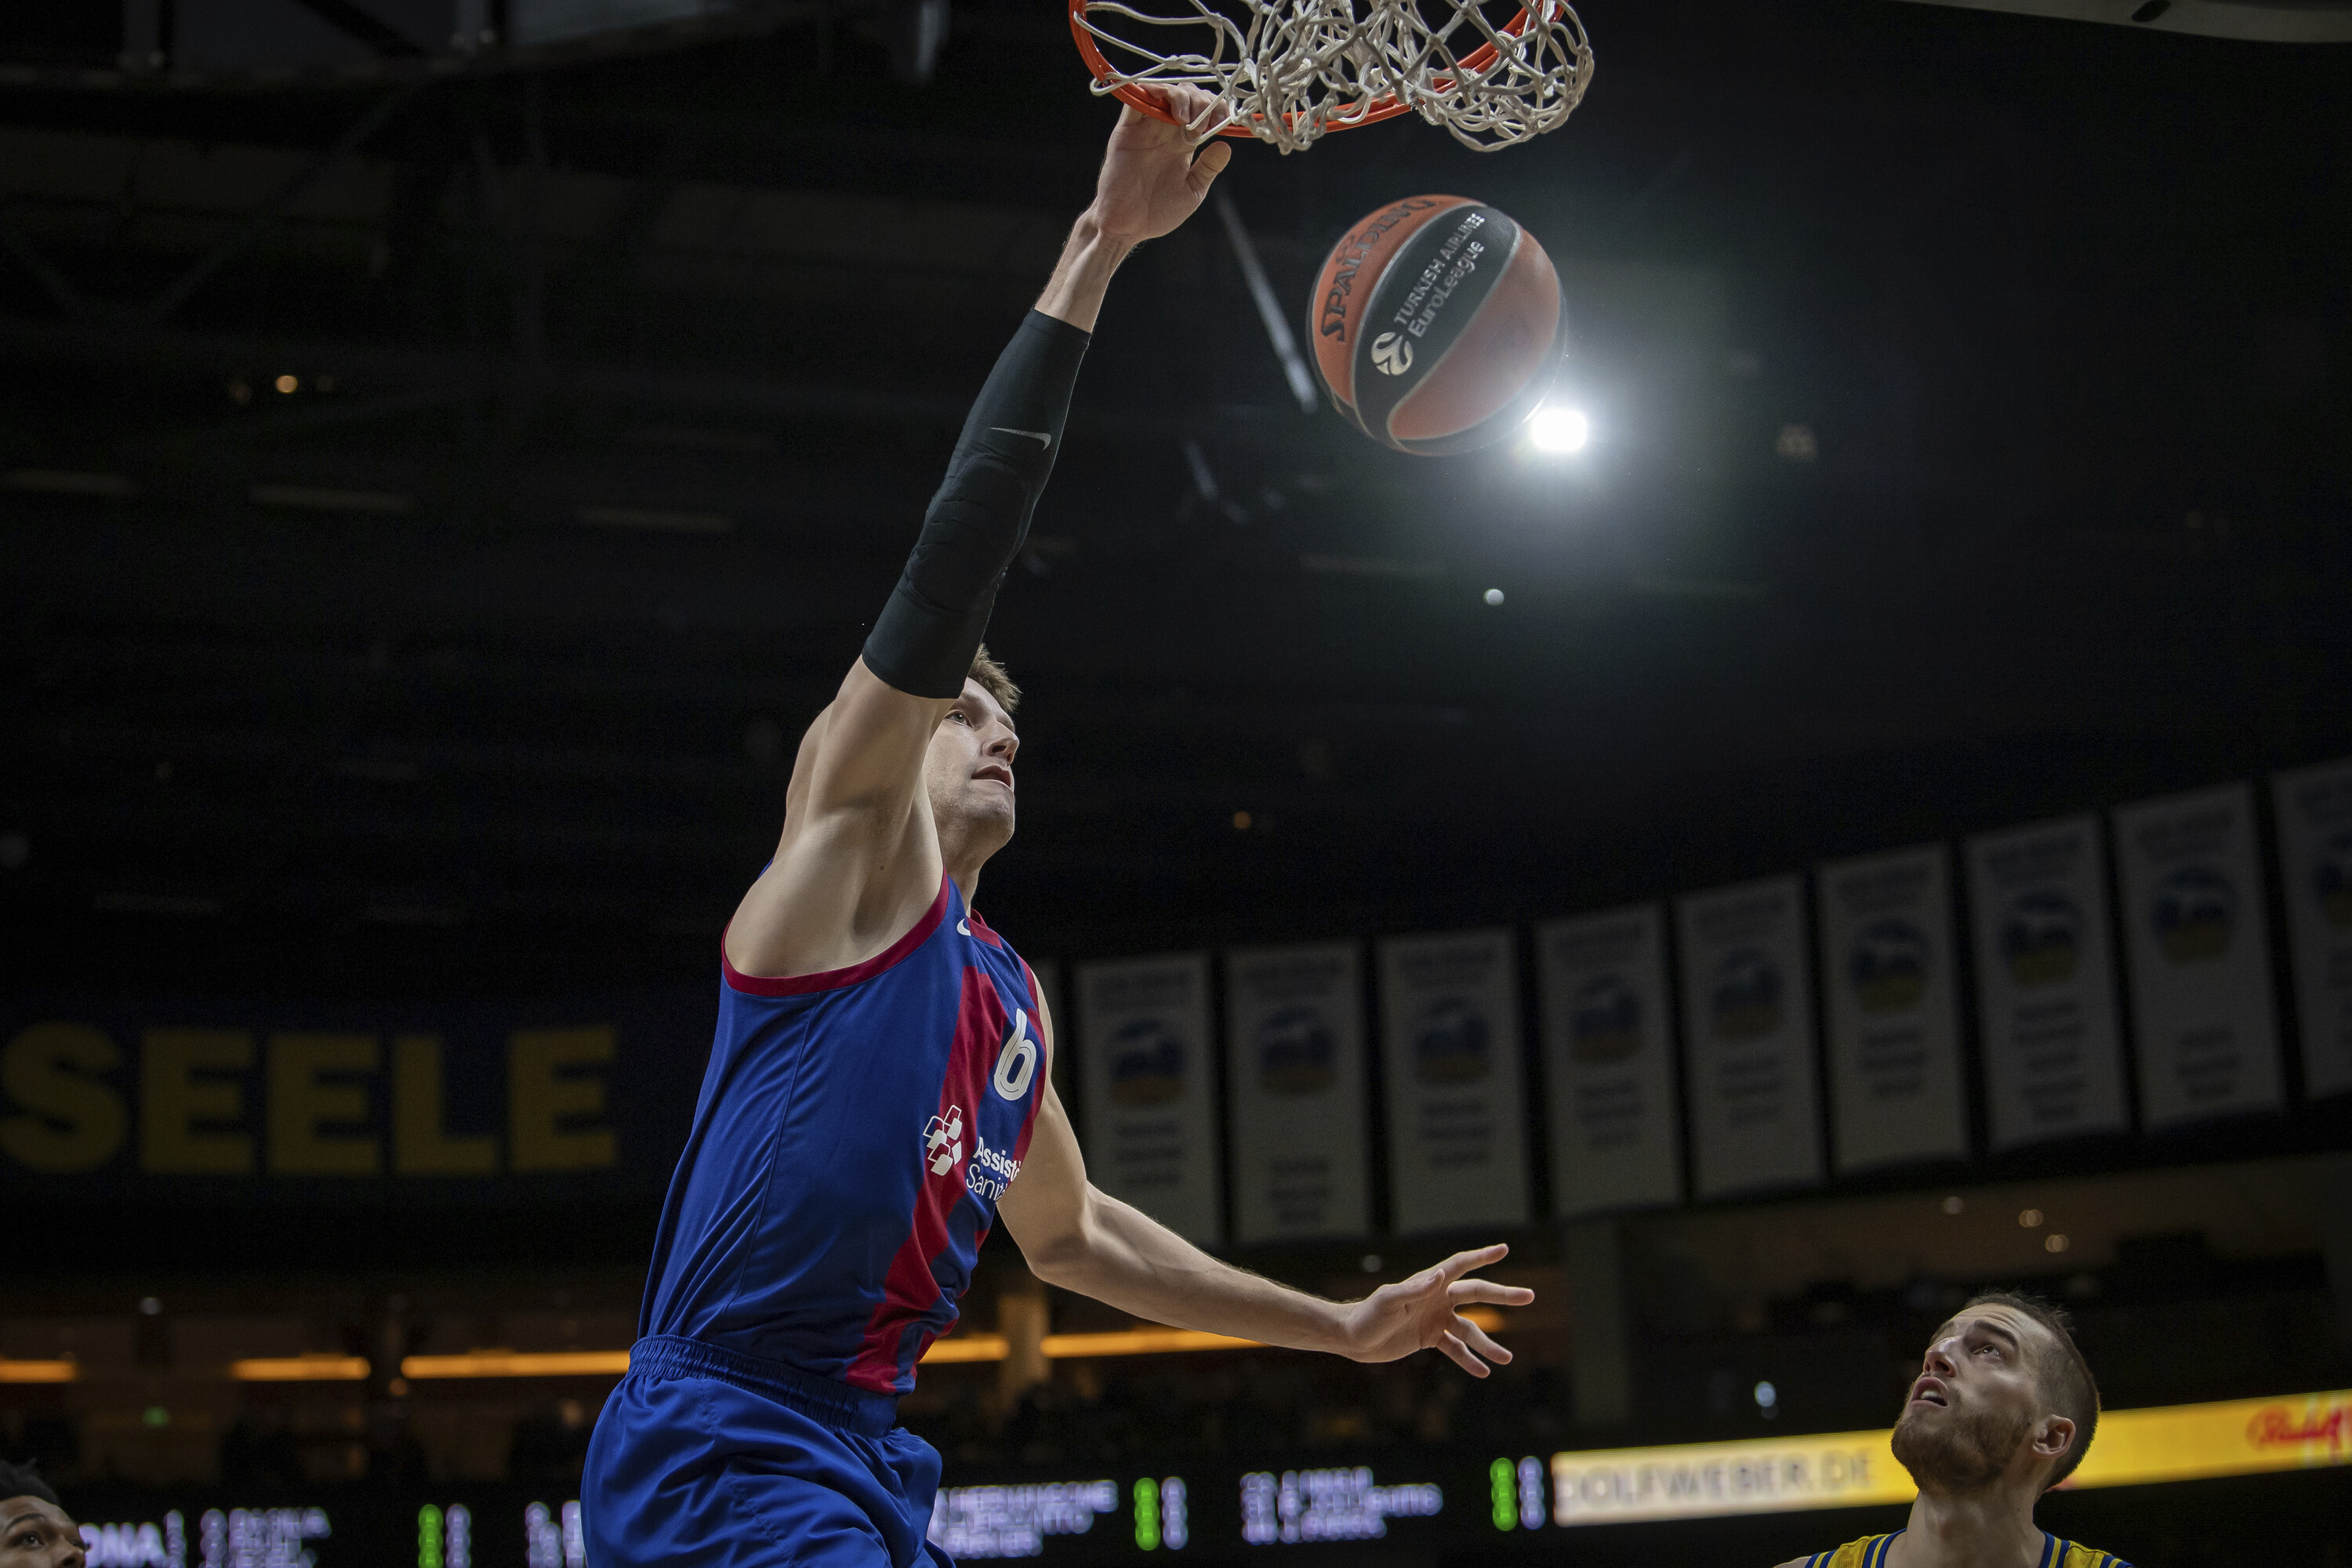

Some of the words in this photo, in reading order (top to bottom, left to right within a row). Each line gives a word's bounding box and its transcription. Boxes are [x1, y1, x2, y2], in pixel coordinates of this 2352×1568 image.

[1321, 199, 1436, 342] SPALDING
[1394, 258, 1446, 325] TURKISH
[1408, 241, 1485, 337] EuroLeague
[0, 1021, 619, 1175] SEELE
[993, 1008, 1036, 1101] 6
